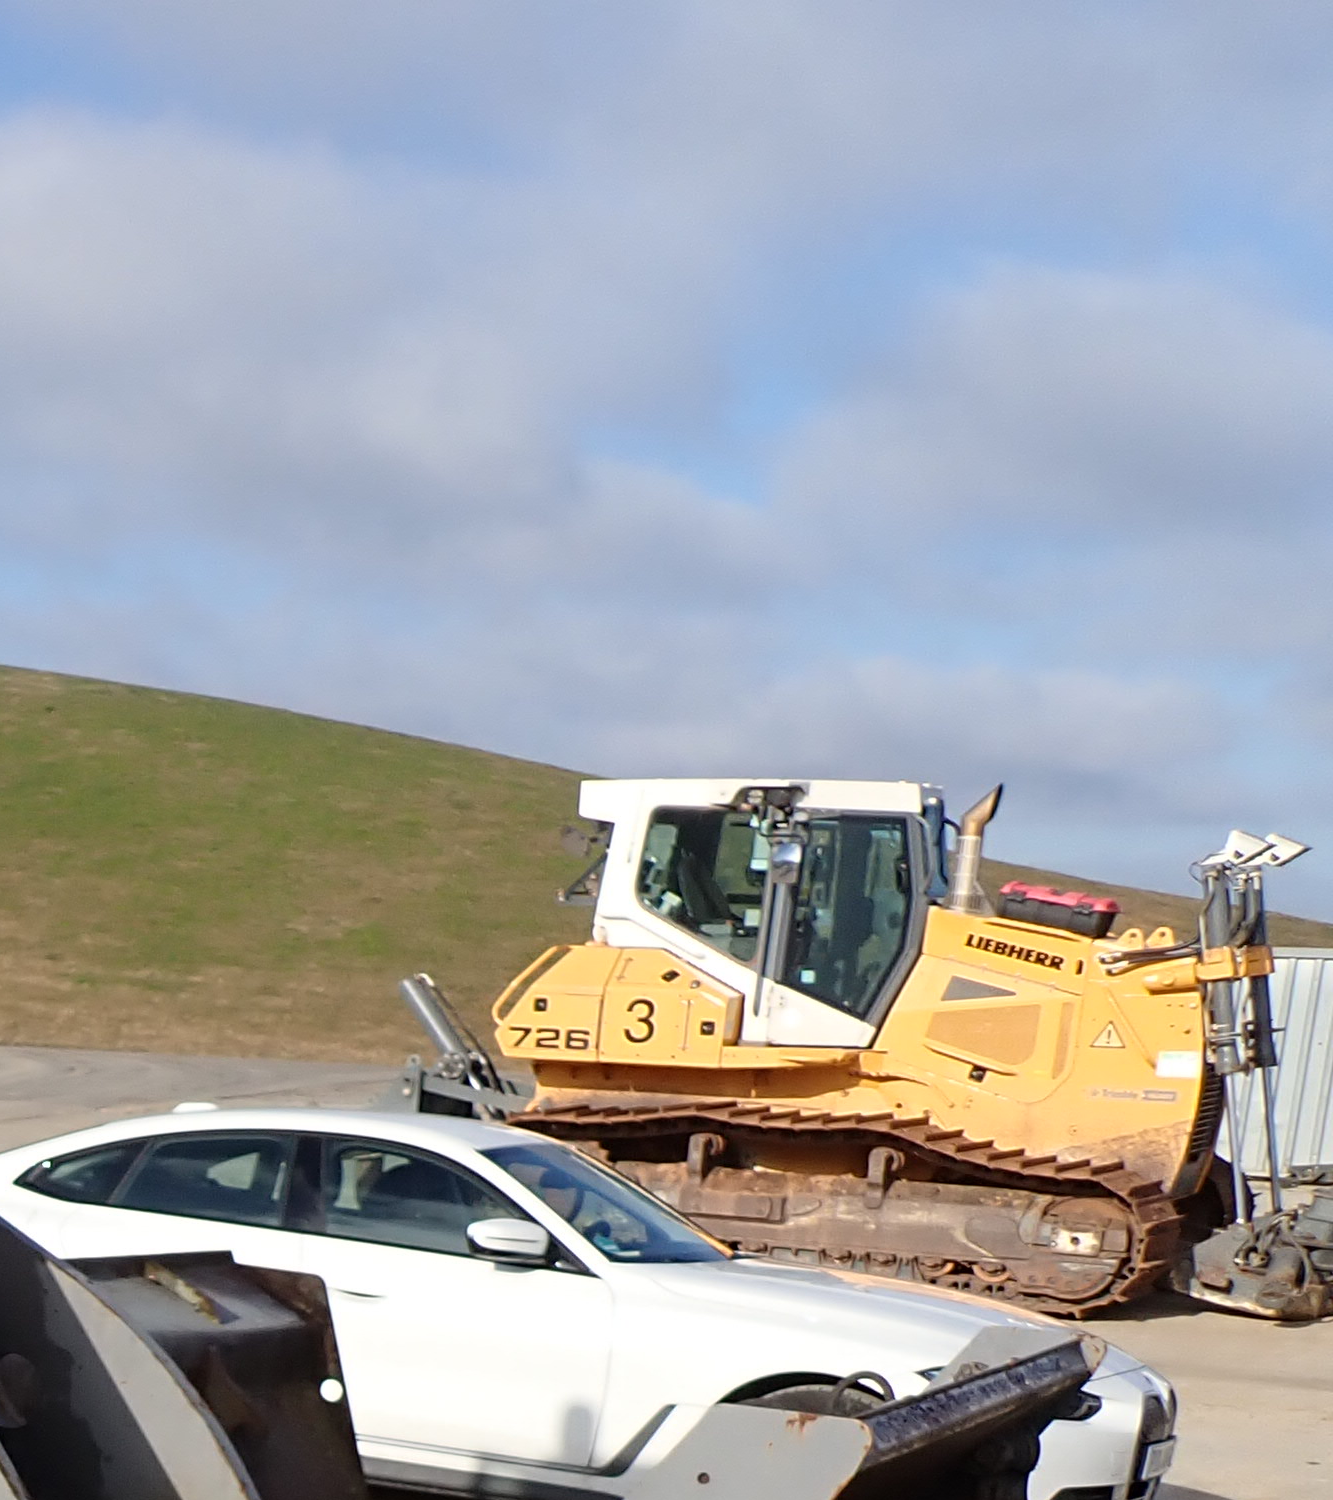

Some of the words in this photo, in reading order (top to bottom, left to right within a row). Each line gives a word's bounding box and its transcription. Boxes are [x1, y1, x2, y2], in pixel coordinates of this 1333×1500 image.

[965, 933, 1065, 971] LIEBHERR
[508, 1026, 591, 1050] 726
[623, 998, 655, 1044] 3
